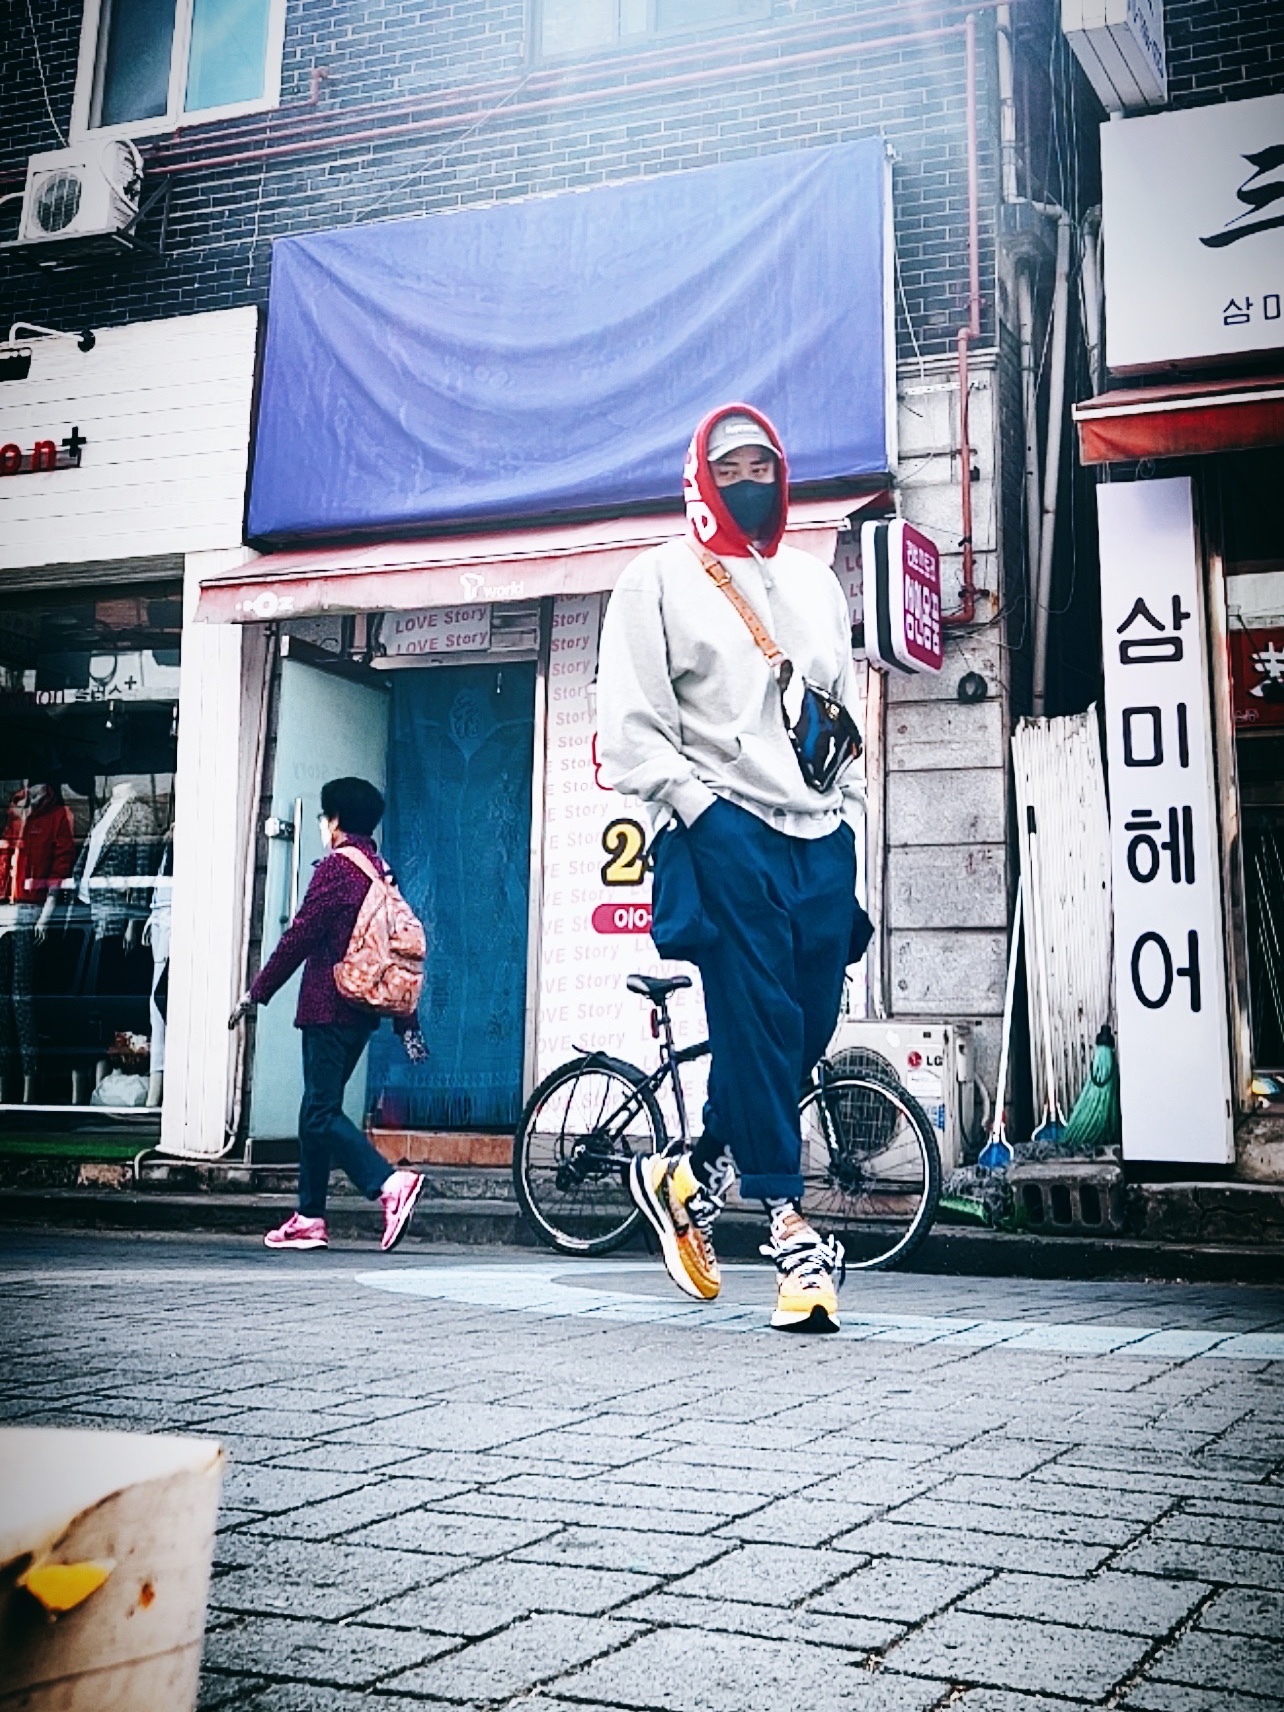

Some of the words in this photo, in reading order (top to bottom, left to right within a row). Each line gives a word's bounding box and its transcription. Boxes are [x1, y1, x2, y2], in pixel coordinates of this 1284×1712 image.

[483, 581, 524, 598] world
[395, 614, 438, 634] LOVE
[444, 607, 486, 625] Story
[552, 611, 590, 628] Story
[397, 638, 438, 653] LOVE
[446, 631, 488, 648] Story
[552, 636, 590, 652] Story
[552, 660, 590, 676] Story
[565, 803, 608, 819] Story
[570, 887, 614, 905] Story
[574, 944, 619, 961] Story
[575, 973, 621, 991] Story
[577, 1002, 623, 1020] Story
[579, 1031, 625, 1049] Story
[926, 1055, 943, 1066] LG
